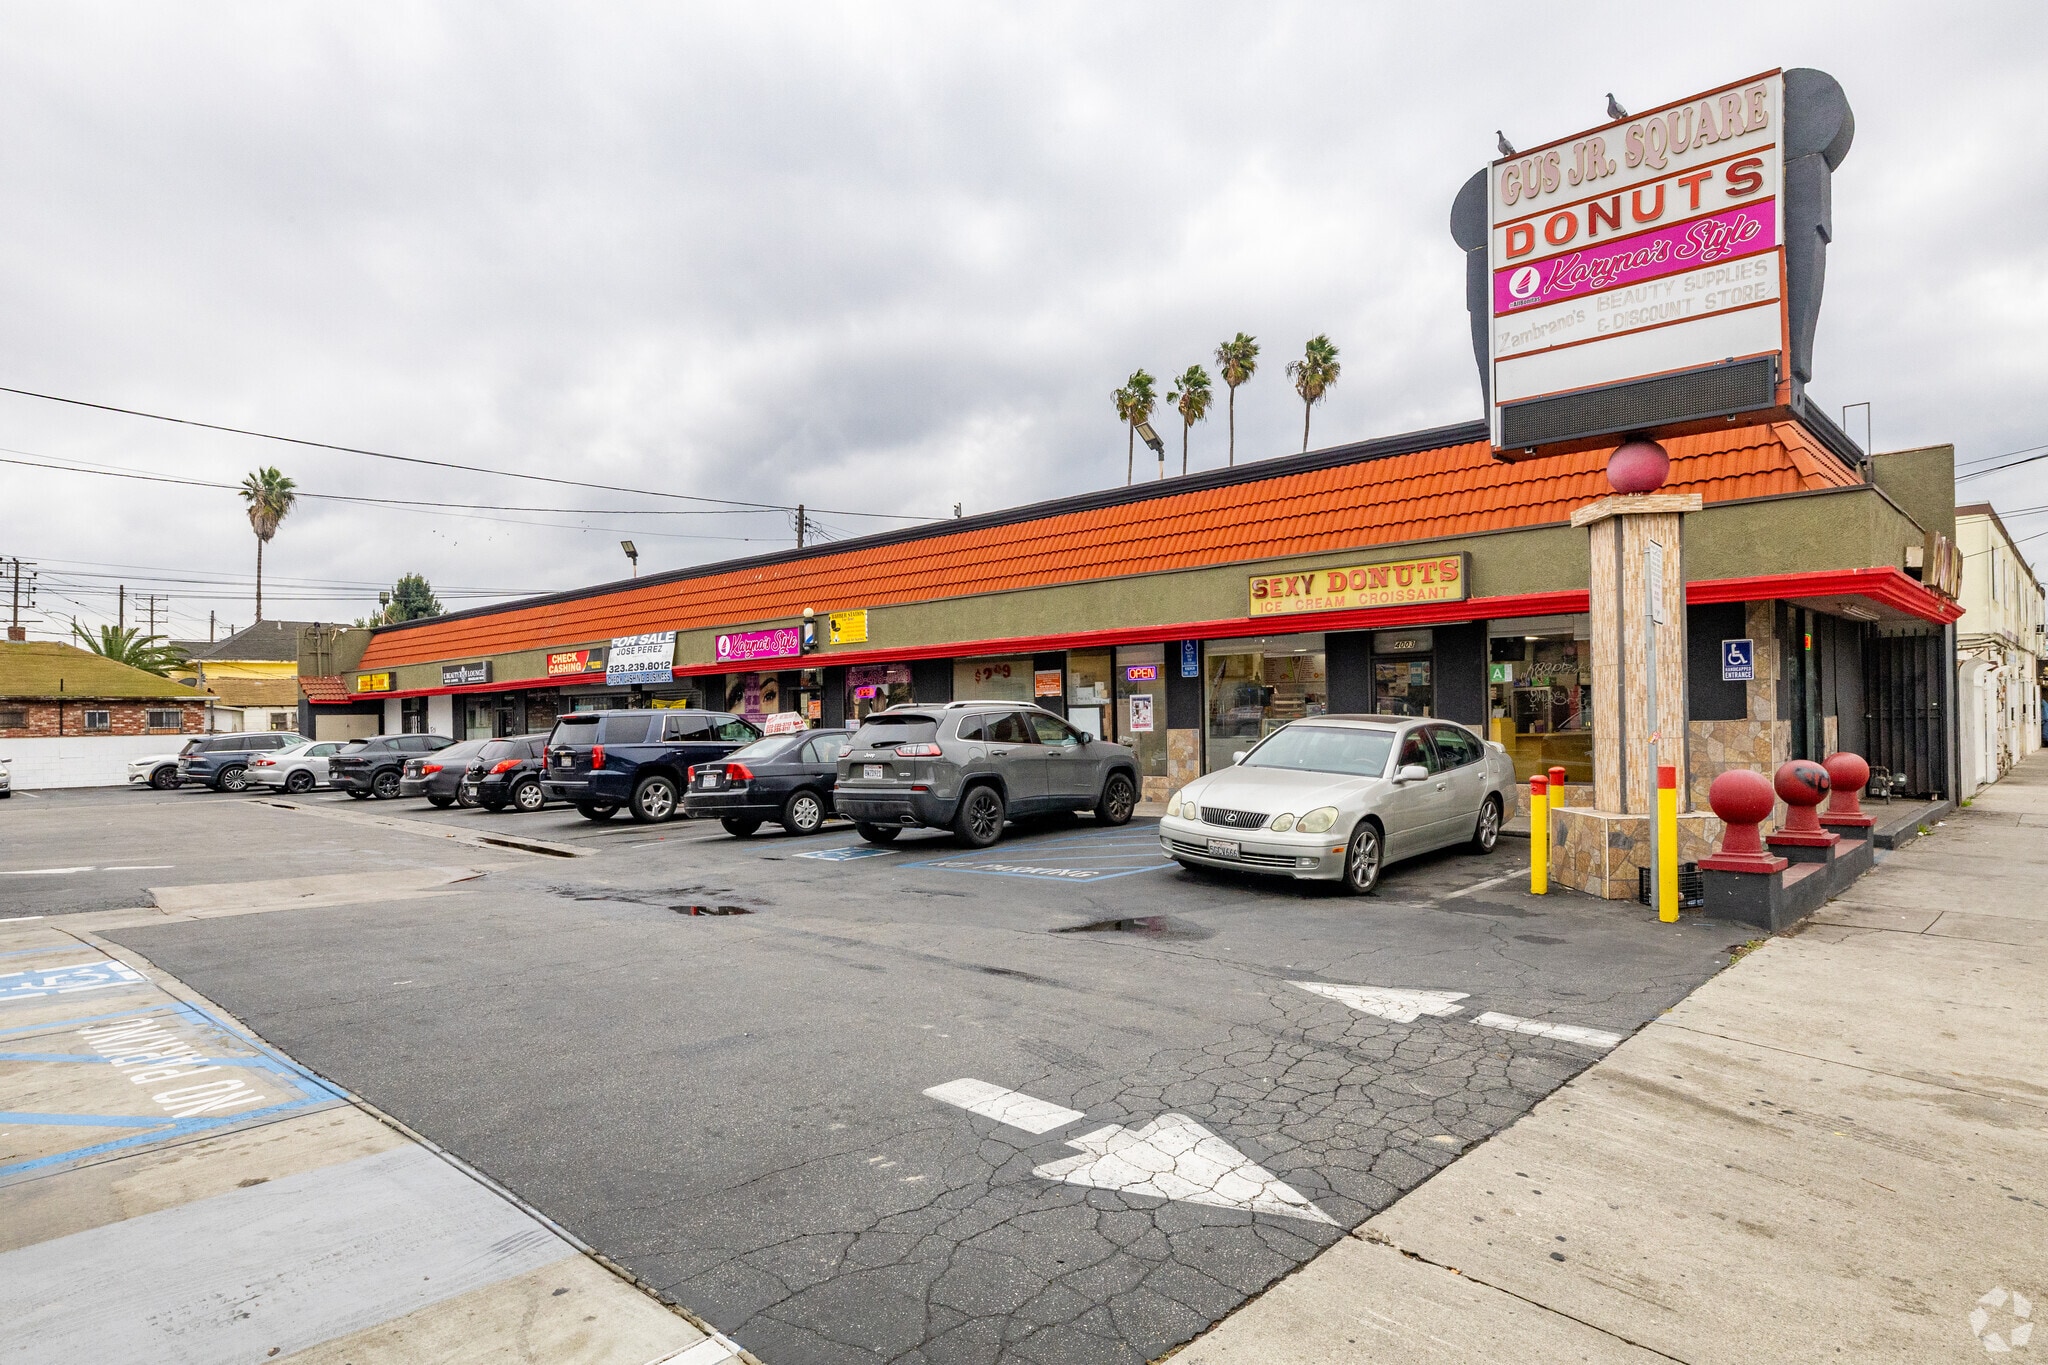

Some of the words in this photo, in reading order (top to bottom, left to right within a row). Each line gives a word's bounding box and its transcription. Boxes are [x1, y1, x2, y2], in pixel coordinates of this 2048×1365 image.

[1501, 150, 1561, 206] GUS
[1568, 137, 1617, 186] JR.
[1624, 83, 1769, 170] SQUARE
[1505, 157, 1764, 260] DONUTS
[1543, 240, 1672, 294] Karyna's
[1676, 214, 1761, 261] Style
[1597, 280, 1676, 313] BEAUTY
[1684, 260, 1768, 293] SUPPLIES
[1612, 297, 1695, 331] DISCOUNT
[1704, 282, 1767, 310] STORE
[1497, 309, 1586, 351] Zambrano's
[1251, 574, 1315, 599] SEXY
[1327, 559, 1459, 593] DONUTS
[1260, 602, 1282, 613] ICE
[1295, 596, 1345, 611] CREAM
[1358, 586, 1449, 605] CROISSANT
[612, 636, 638, 648] FOR
[638, 631, 676, 645] SALE
[617, 647, 636, 656] JOSE
[637, 645, 663, 654] PEREZ
[730, 634, 771, 659] Karyna's
[771, 630, 797, 655] Style
[1394, 641, 1415, 649] 4003
[549, 662, 581, 674] CASHING
[552, 652, 578, 664] CHECK
[608, 661, 671, 674] 323.239.8012
[1129, 668, 1154, 679] OPEN
[1493, 669, 1502, 679] A
[972, 864, 1100, 878] PARKING
[76, 1017, 221, 1085] PARKING
[152, 1079, 266, 1119] NO
